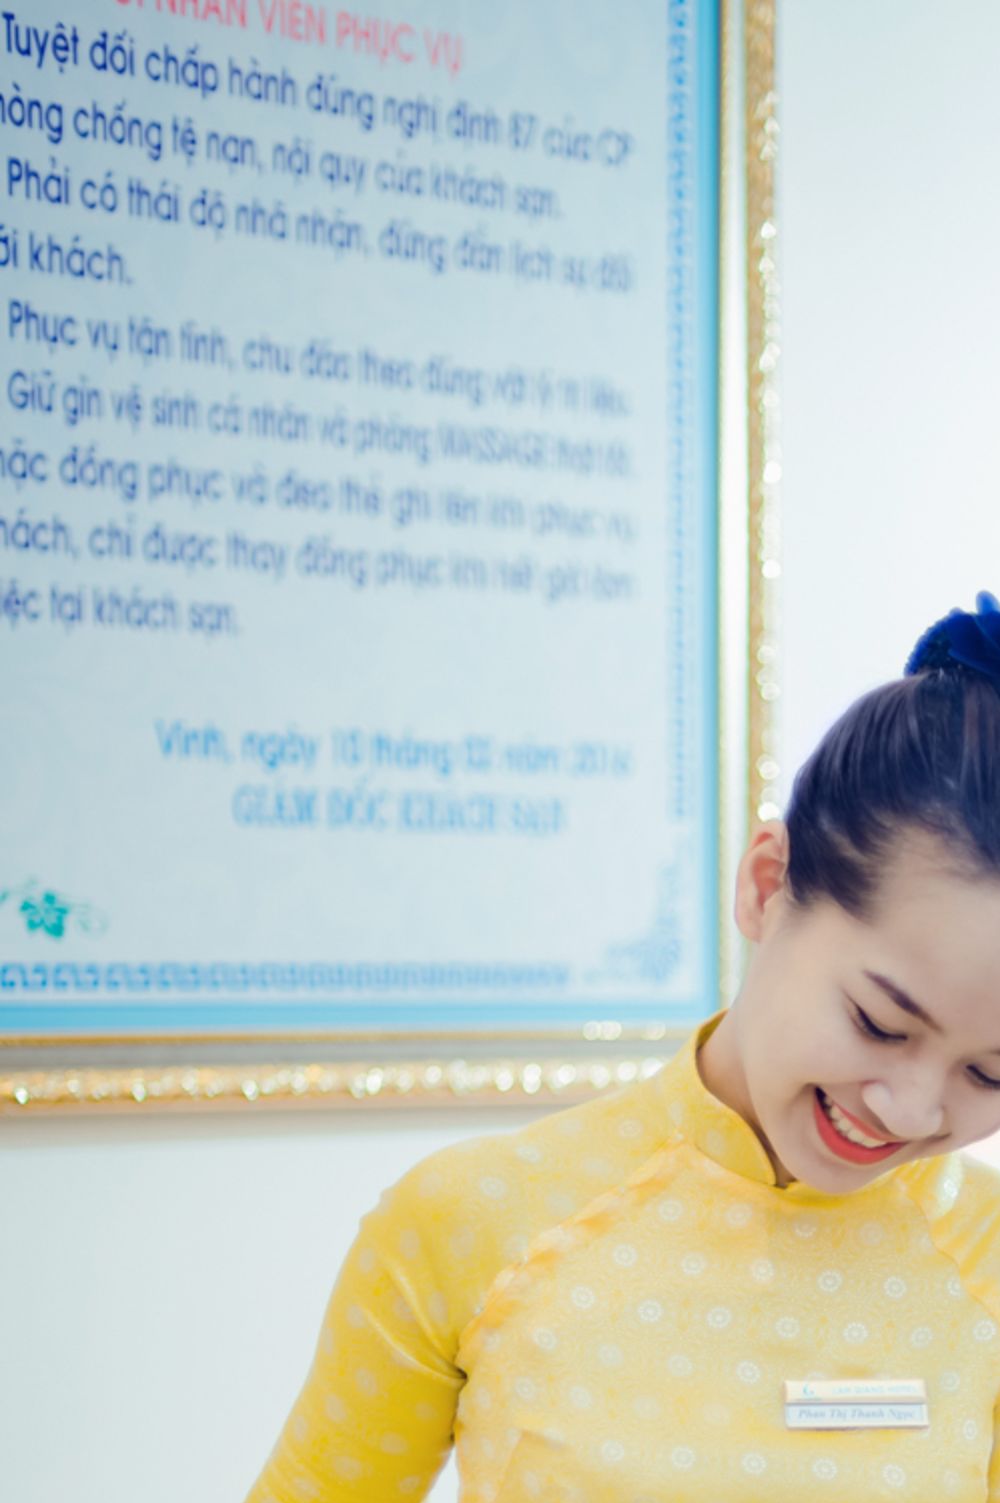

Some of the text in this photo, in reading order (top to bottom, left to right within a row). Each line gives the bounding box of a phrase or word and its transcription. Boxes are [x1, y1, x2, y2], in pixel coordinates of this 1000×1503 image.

[336, 10, 415, 65] PHỤC
[2, 11, 79, 73] Tuyệt
[90, 29, 136, 77] đối
[145, 43, 219, 98] chấp
[228, 56, 297, 106] hành
[306, 73, 375, 132] đúng
[73, 100, 162, 161] chống
[172, 116, 197, 166] tệ
[320, 152, 366, 195] quy
[8, 156, 70, 205] Phải
[80, 171, 118, 213] có
[128, 176, 180, 222] thái
[189, 189, 226, 241] độ
[28, 231, 134, 286] khách.
[8, 299, 77, 354] Phục
[87, 319, 120, 361] vụ
[7, 369, 55, 414] Giữ
[62, 374, 103, 426] gìn
[111, 384, 143, 434] vệ
[152, 390, 199, 430] sinh
[149, 455, 225, 505] phục
[0, 578, 40, 630] ệc
